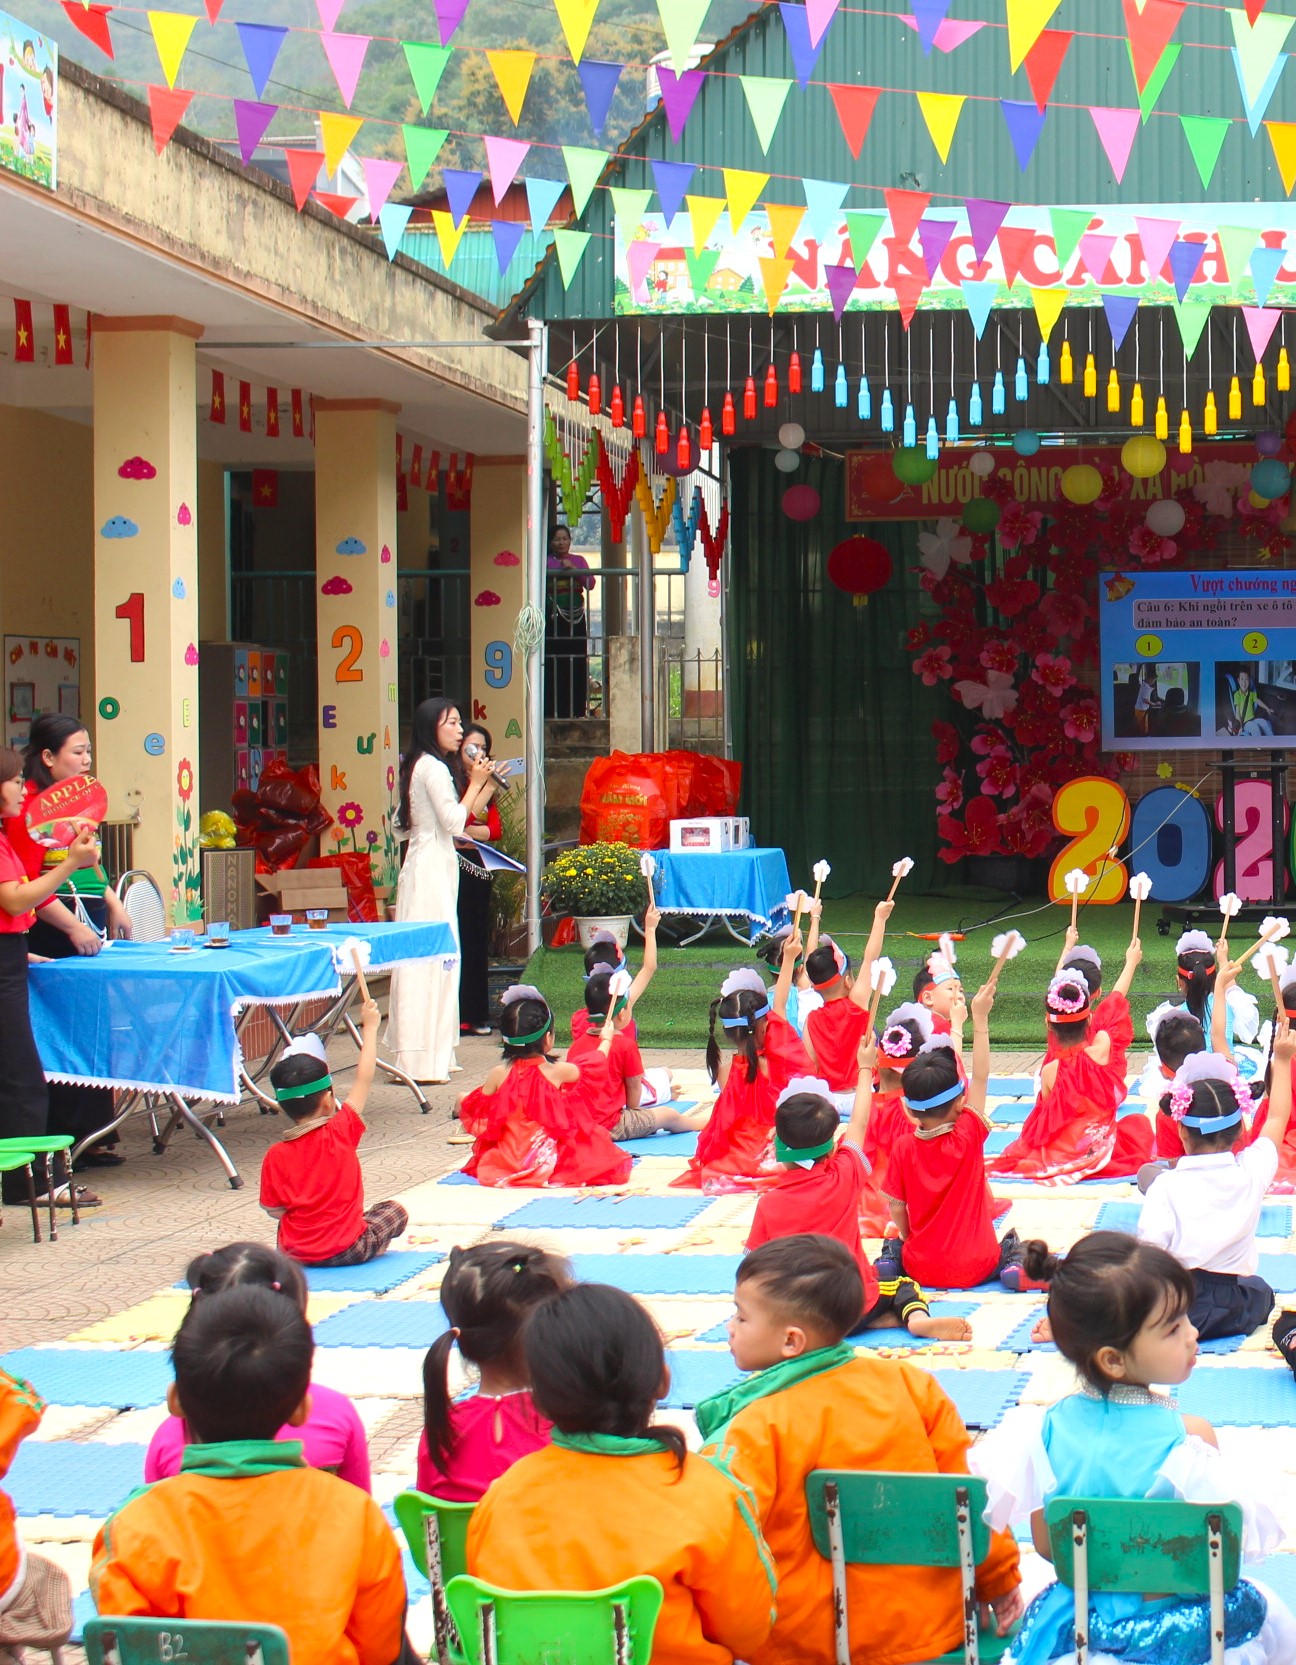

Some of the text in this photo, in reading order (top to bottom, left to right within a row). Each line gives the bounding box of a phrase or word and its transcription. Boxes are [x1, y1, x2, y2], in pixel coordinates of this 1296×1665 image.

[1190, 574, 1225, 596] Vượt
[1228, 576, 1278, 593] chướng
[1137, 602, 1160, 612] Câu
[1164, 602, 1175, 612] 6:
[1178, 601, 1199, 612] Khi
[1202, 599, 1227, 613] ngồi
[1230, 601, 1253, 611] trên
[1257, 603, 1269, 611] xe
[1272, 601, 1279, 610] ô
[1282, 601, 1293, 610] tô
[116, 593, 145, 662] 1
[1189, 620, 1203, 628] an
[1206, 616, 1237, 627] toàn?
[331, 625, 363, 682] 2
[1251, 638, 1259, 649] 2
[485, 641, 513, 689] 9
[322, 705, 337, 729] E
[473, 699, 488, 720] k
[505, 718, 523, 739] A
[144, 733, 166, 756] e
[357, 732, 377, 755] ư
[331, 765, 347, 790] k
[158, 1631, 188, 1661] B2
